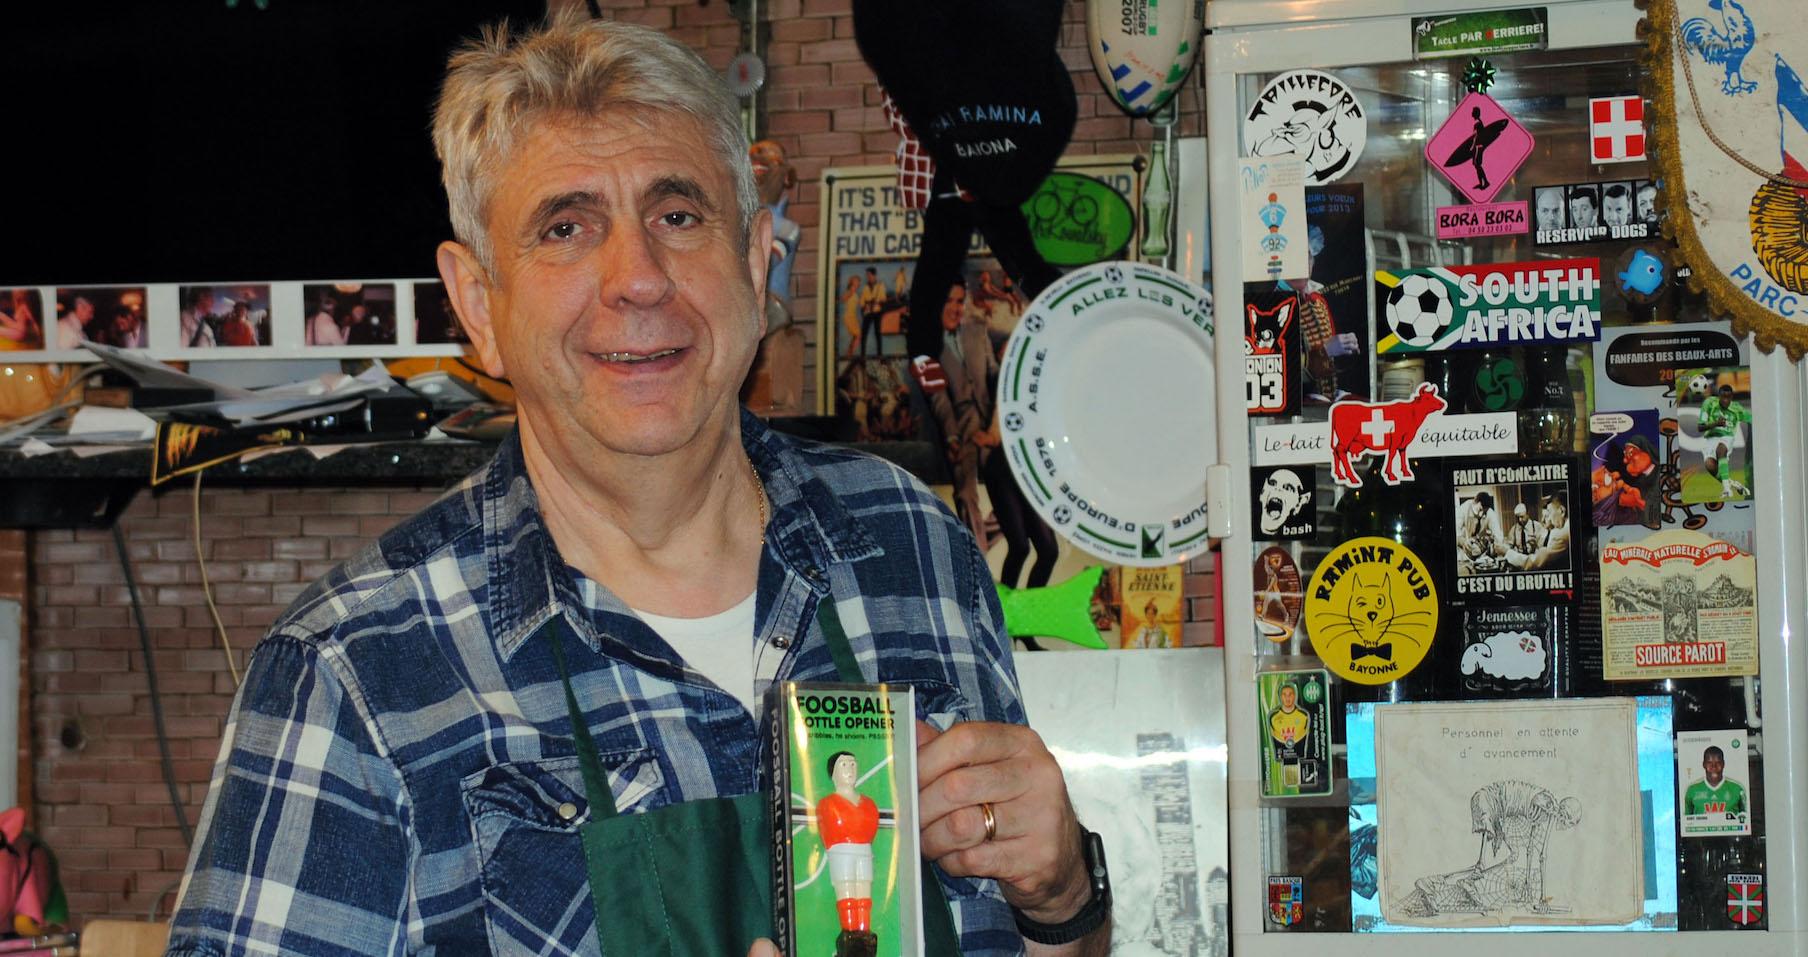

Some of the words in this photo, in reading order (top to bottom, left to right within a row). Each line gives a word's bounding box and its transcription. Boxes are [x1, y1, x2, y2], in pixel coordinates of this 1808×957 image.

[1121, 0, 1133, 36] 2007
[1431, 36, 1458, 47] TACLE
[1460, 31, 1483, 43] PAR
[959, 105, 1042, 126] RAMINA
[838, 187, 876, 208] IT'S
[838, 211, 892, 232] THAT
[1440, 212, 1479, 228] BORA
[1485, 209, 1524, 225] BORA
[1536, 226, 1607, 244] RESERVOIR
[1612, 224, 1648, 240] DOGS
[836, 235, 876, 256] FUN
[1459, 268, 1593, 307] SOUTH
[1730, 263, 1798, 317] PARC
[1071, 287, 1128, 316] ALLEZ
[1138, 287, 1174, 307] LES
[1181, 305, 1215, 337] VER
[1461, 304, 1596, 343] AFRICA
[1609, 352, 1655, 364] FANFARES
[1656, 351, 1674, 363] DES
[1675, 348, 1733, 360] BEAUX-ARTS
[1659, 369, 1674, 381] 20
[1420, 423, 1512, 447] équitable
[1035, 437, 1056, 478] 1976
[1453, 468, 1483, 486] FAUT
[1059, 482, 1136, 533] D'EUROPE
[1171, 503, 1208, 530] OUPE
[1282, 523, 1313, 535] bash
[1604, 548, 1617, 559] EAU
[1653, 545, 1701, 560] NATURELLE
[1397, 557, 1430, 601] PUB
[1457, 576, 1493, 594] C'EST
[1495, 575, 1513, 592] DU
[1516, 574, 1566, 590] BRUTAL
[1636, 645, 1683, 665] SOURCE
[1684, 643, 1724, 663] PAROT
[1349, 661, 1399, 675] BAYONNE
[796, 695, 895, 715] FOOSBALL
[803, 716, 841, 729] OTTLE
[845, 717, 895, 730] OPENER
[1441, 727, 1504, 738] Personnel
[1517, 728, 1531, 737] en
[1539, 727, 1579, 737] attente
[1483, 748, 1558, 759] avancement
[770, 708, 783, 825] FOOSBALL
[774, 831, 786, 909] BOTTLE
